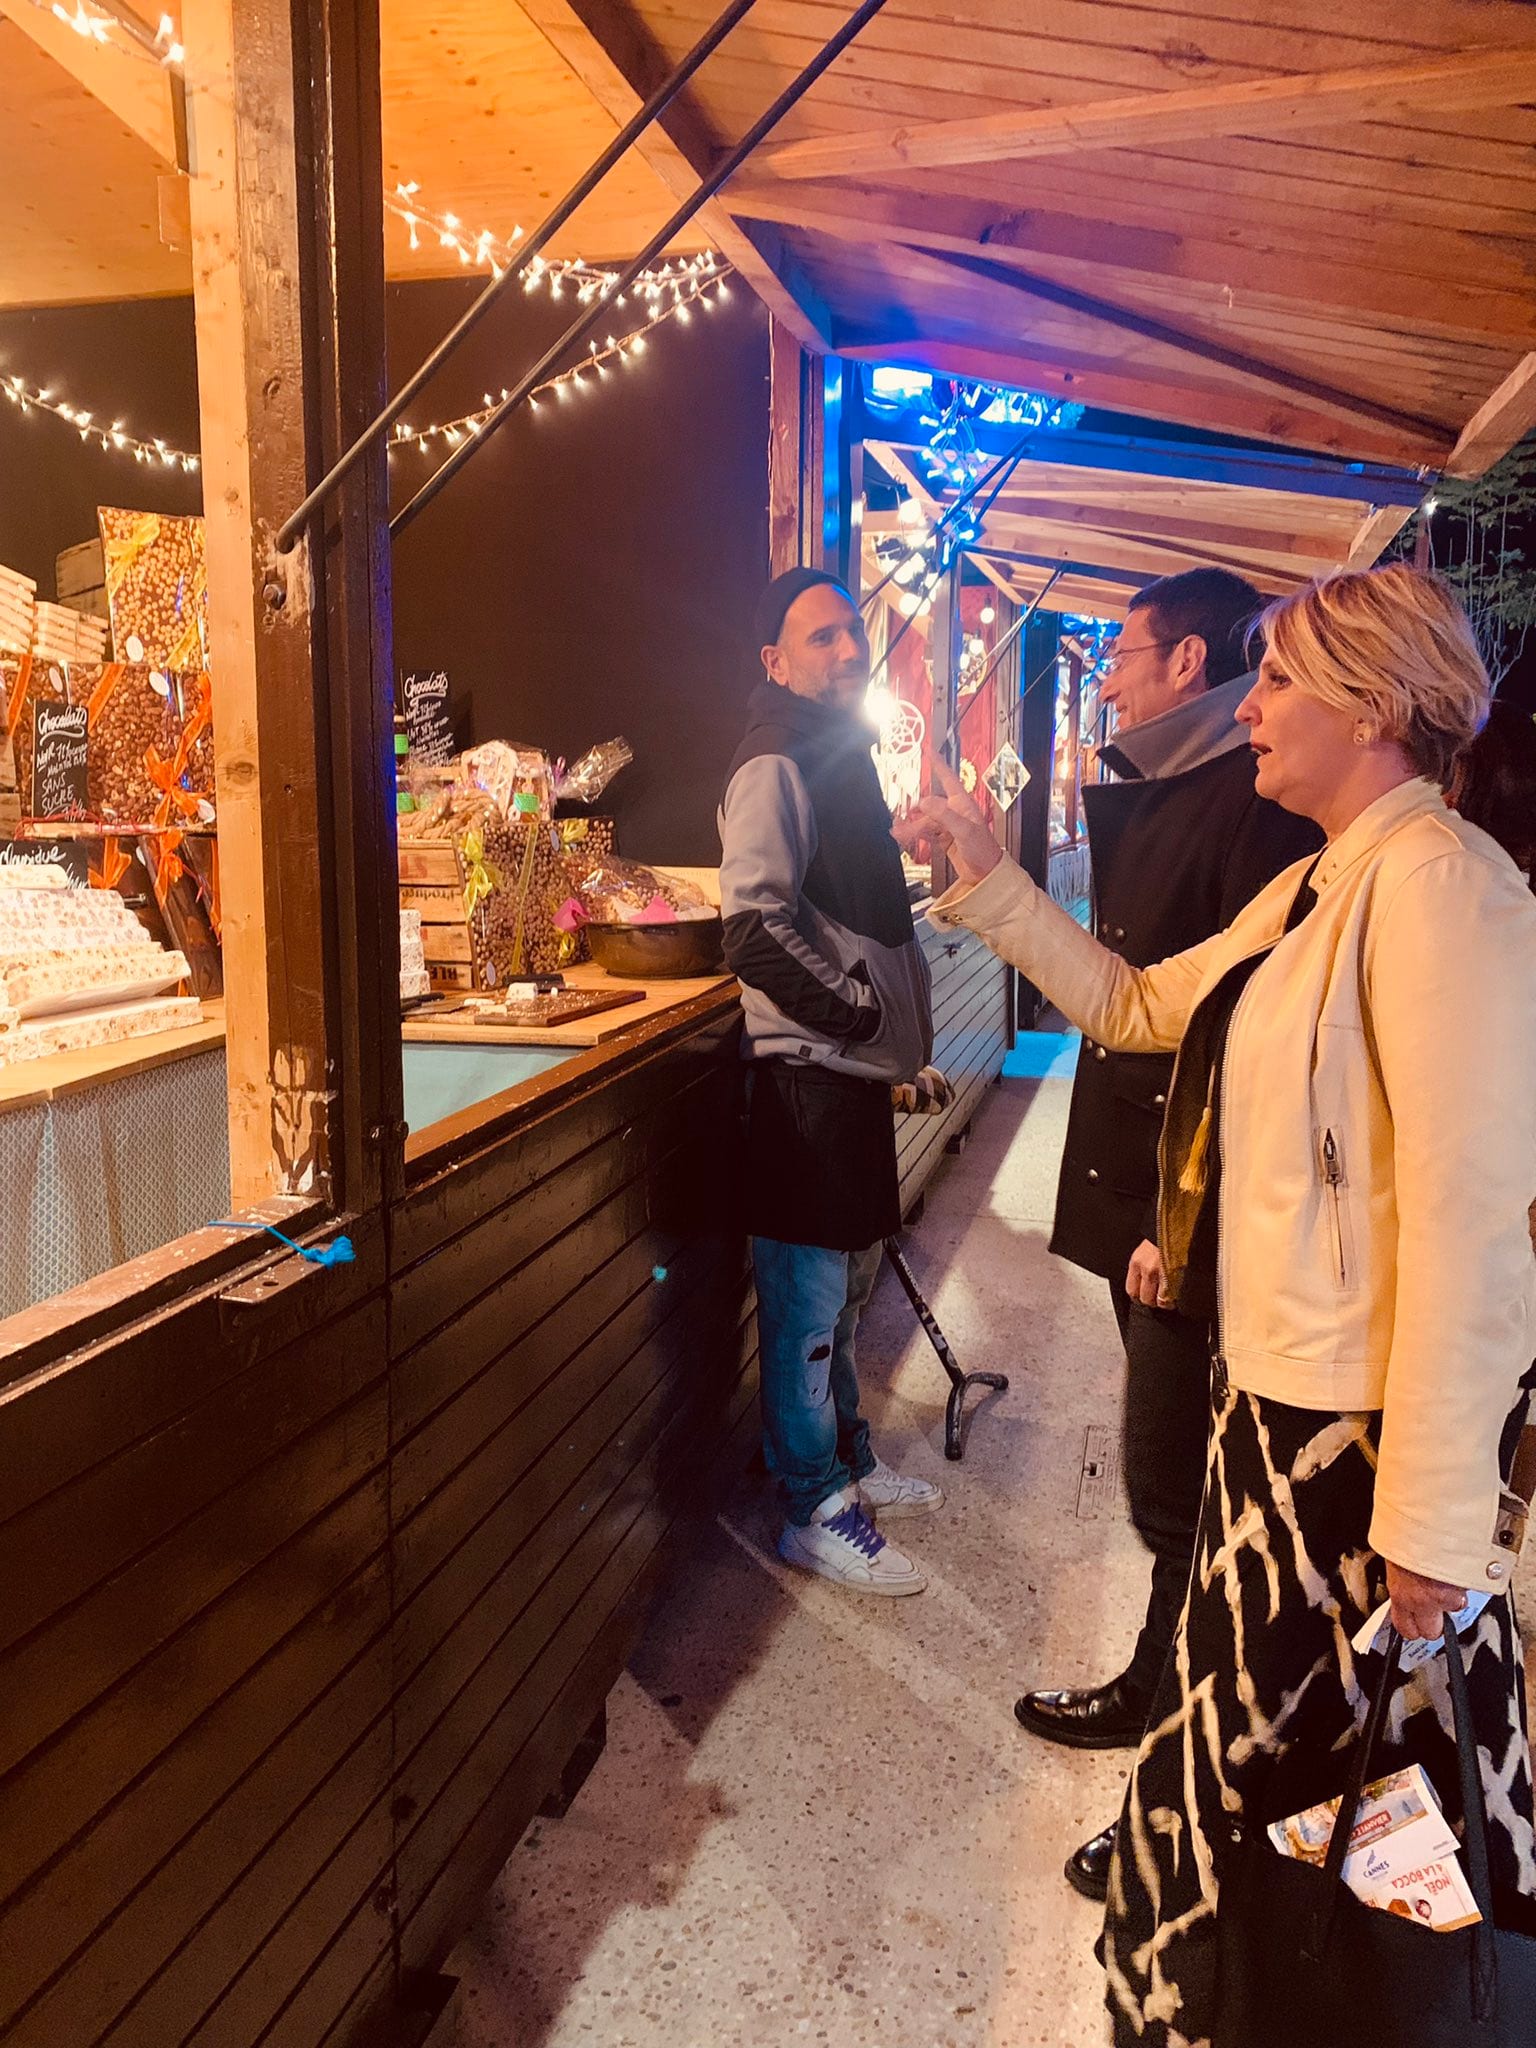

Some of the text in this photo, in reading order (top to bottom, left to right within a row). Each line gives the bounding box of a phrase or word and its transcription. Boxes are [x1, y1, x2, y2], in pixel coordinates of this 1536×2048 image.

[38, 705, 88, 735] Chocolats
[41, 771, 66, 798] SANS
[41, 783, 75, 816] SUCRE
[1363, 1860, 1390, 1879] CANNES
[1391, 1868, 1424, 1889] BOCCA
[1424, 1864, 1438, 1877] LA
